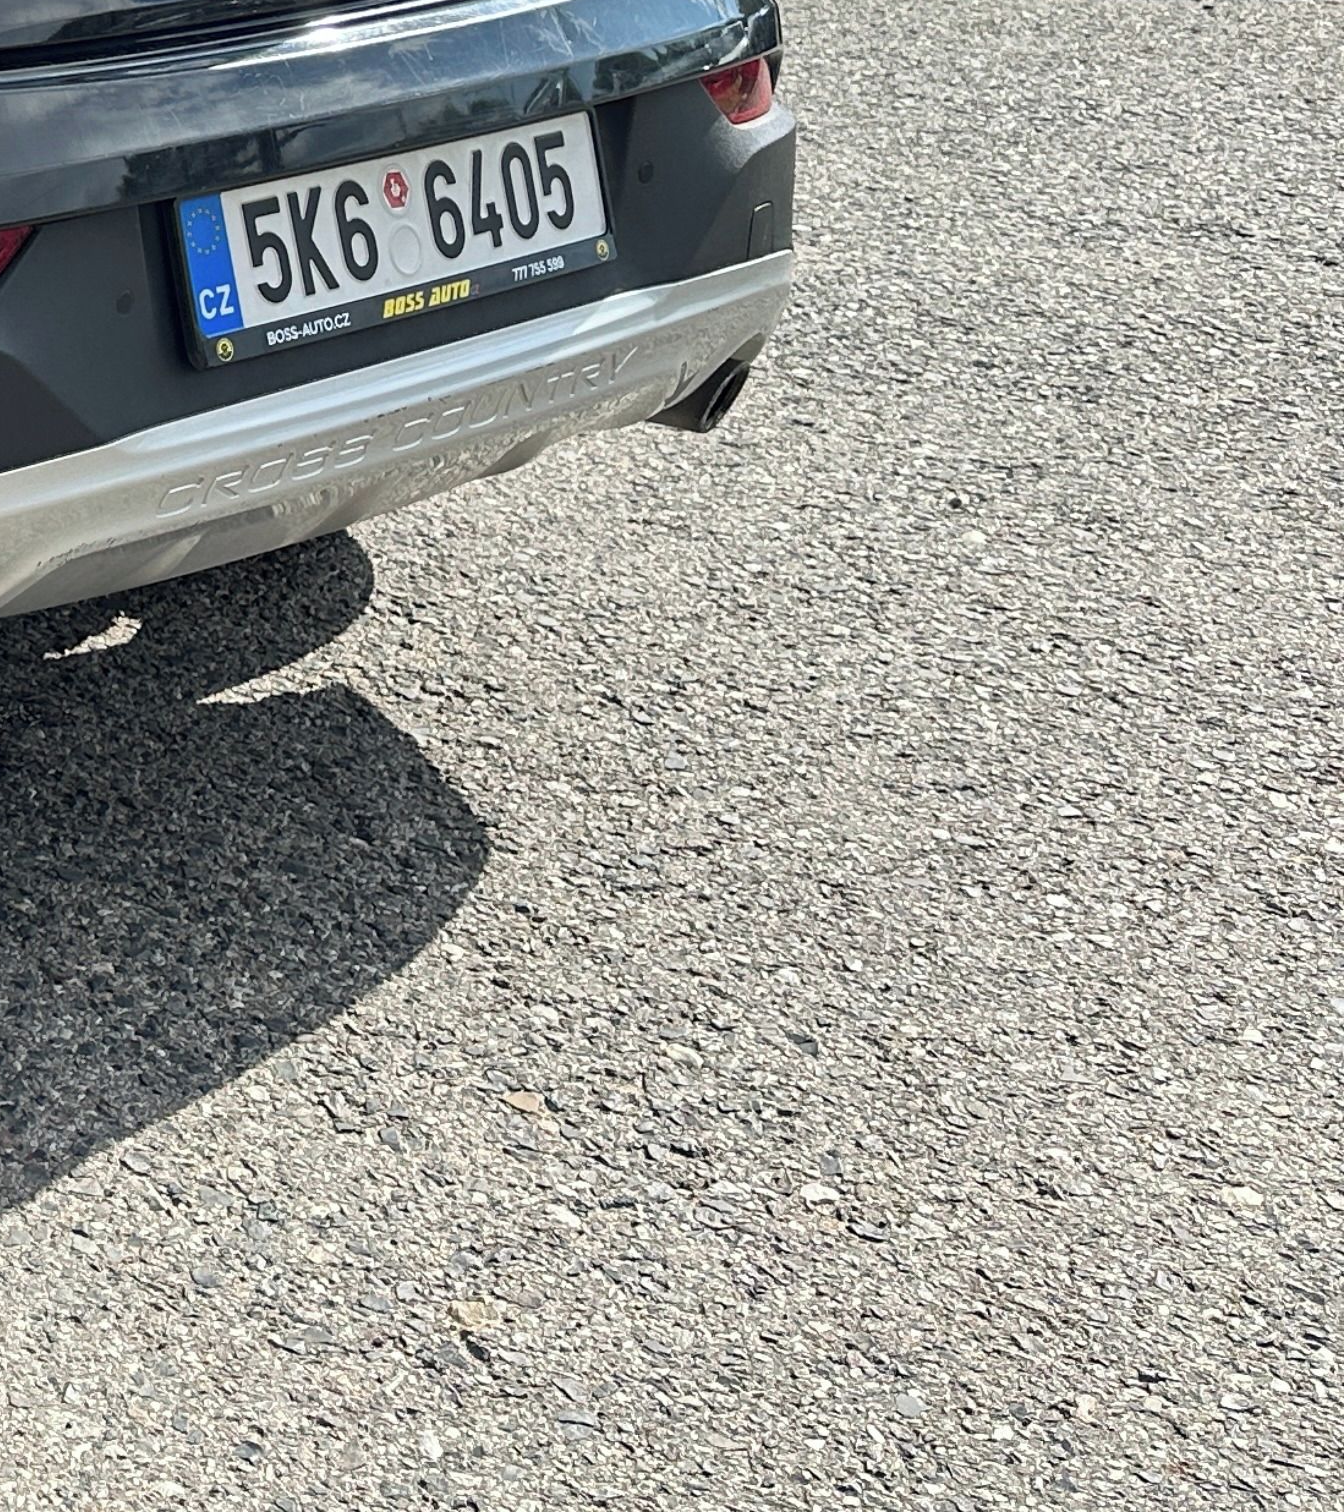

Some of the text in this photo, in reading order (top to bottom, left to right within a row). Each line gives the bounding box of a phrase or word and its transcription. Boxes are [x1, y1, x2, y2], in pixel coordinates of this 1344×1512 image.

[240, 129, 576, 305] 5K6 6405
[511, 264, 528, 282] 777
[198, 284, 235, 320] CZ
[382, 290, 425, 319] BOSS
[428, 279, 472, 307] AUTO
[266, 312, 352, 346] BOSS-AUTO.CZ
[154, 345, 640, 520] CROSS COUNTRY
